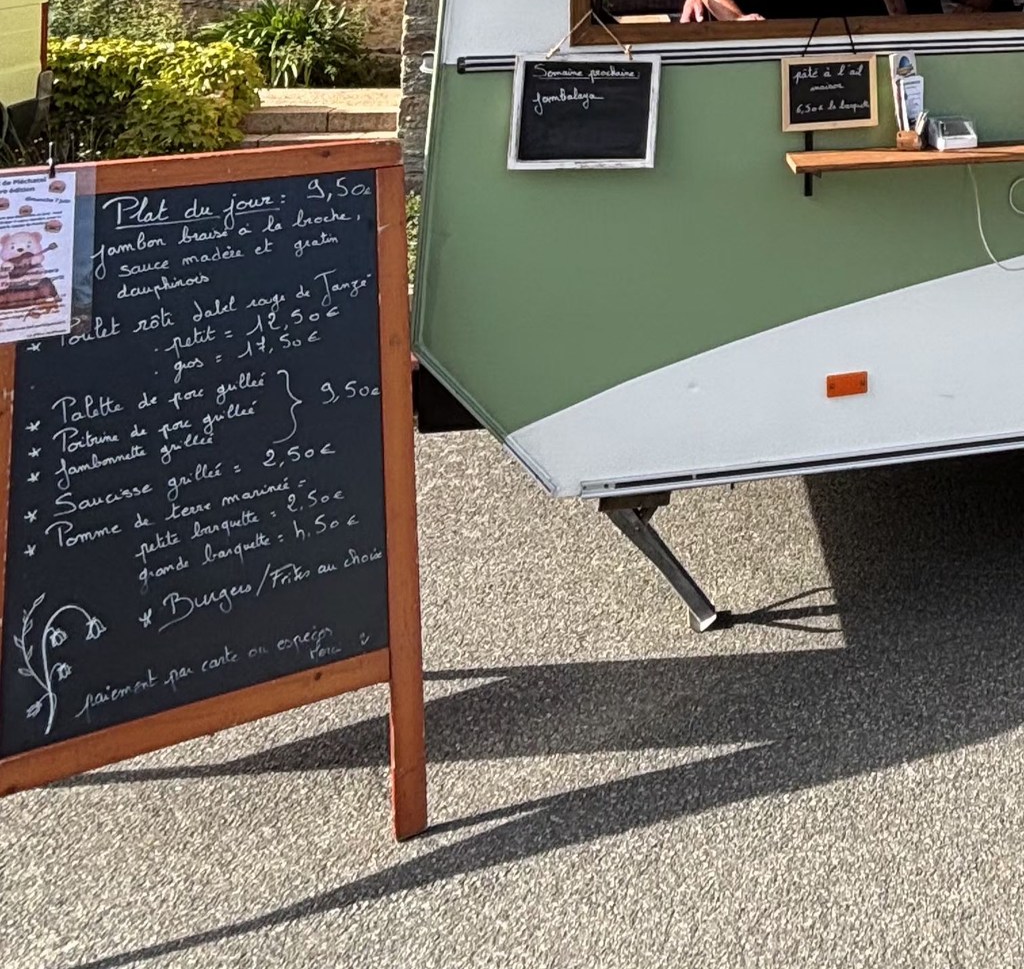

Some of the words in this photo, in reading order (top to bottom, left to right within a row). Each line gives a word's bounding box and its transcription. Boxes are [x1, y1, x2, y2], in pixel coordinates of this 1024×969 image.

[532, 62, 584, 78] Semaine
[822, 66, 832, 78] à
[102, 196, 169, 225] Plat
[184, 198, 214, 219] du
[237, 222, 252, 236] à
[262, 214, 283, 233] la
[118, 259, 170, 278] sauce
[254, 237, 273, 255] et
[293, 231, 339, 258] gratin
[116, 272, 210, 300] dauphinois
[132, 307, 175, 333] rôti
[296, 284, 311, 299] de
[164, 325, 217, 359] petit
[173, 358, 205, 384] gros
[51, 394, 125, 424] Palette
[137, 392, 159, 410] de
[168, 388, 204, 410] porc
[52, 427, 120, 453] Poitrine
[130, 424, 148, 439] de
[158, 419, 193, 440] porc
[53, 483, 154, 517] Saucisse
[45, 520, 123, 547] Pomme
[134, 512, 154, 529] de
[164, 503, 211, 521] terre
[134, 530, 181, 564] petite
[190, 510, 260, 540] barquette
[138, 555, 190, 596] grande
[201, 532, 272, 566] barquette
[317, 563, 338, 574] au
[343, 547, 383, 568] choix
[75, 668, 159, 719] paiement
[201, 645, 240, 673] carte
